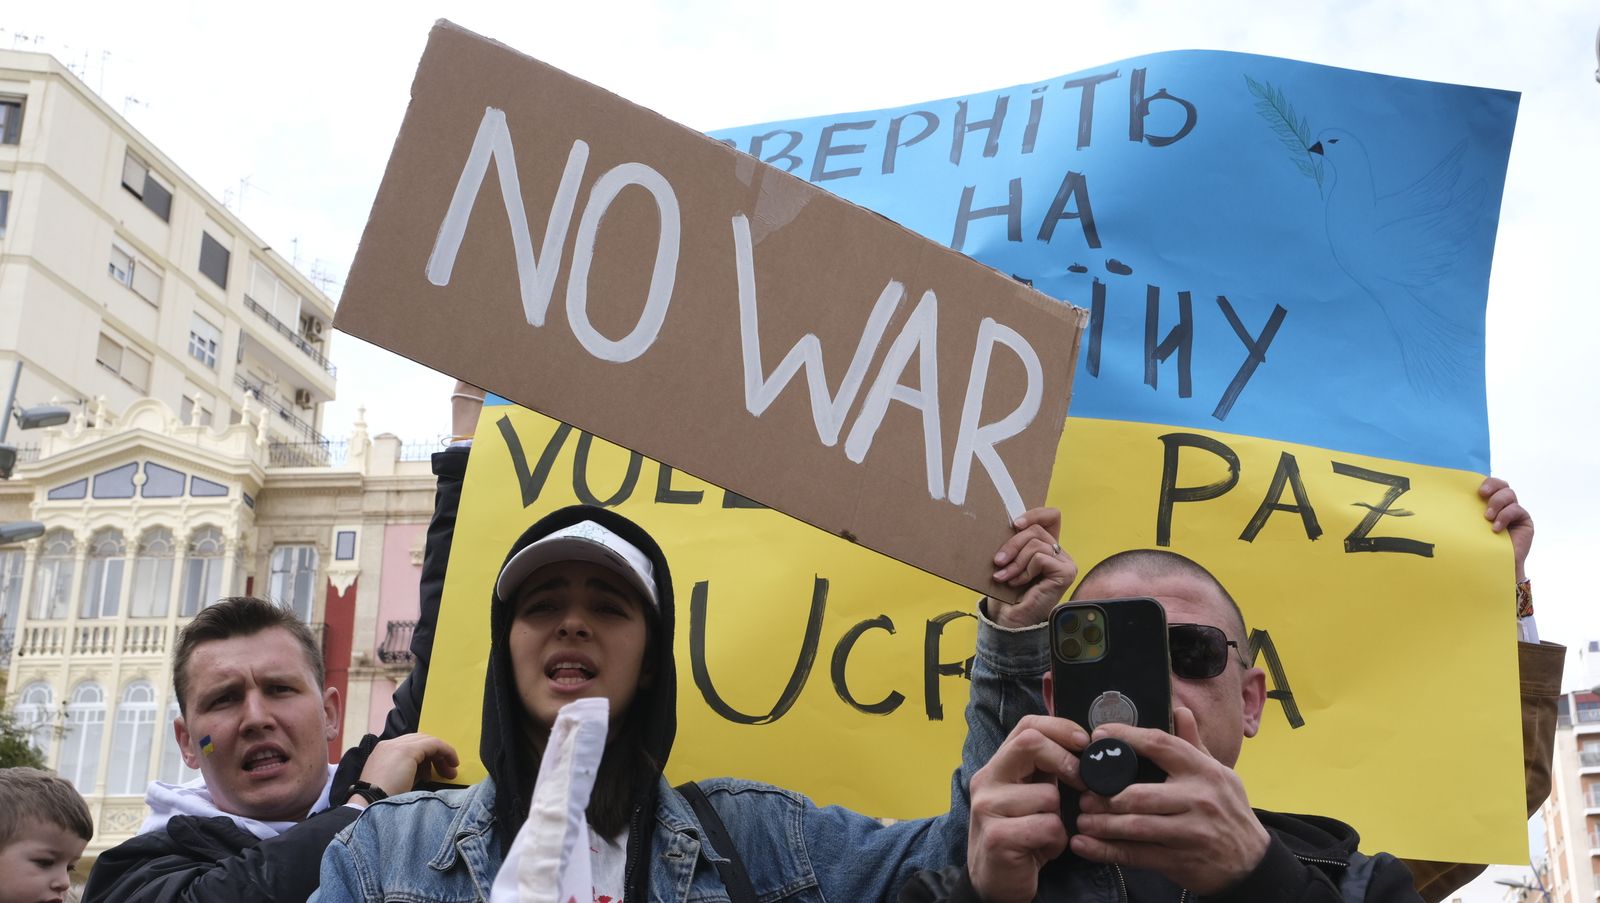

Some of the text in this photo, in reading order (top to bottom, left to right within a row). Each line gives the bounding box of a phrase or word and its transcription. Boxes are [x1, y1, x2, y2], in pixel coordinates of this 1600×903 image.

[951, 170, 1103, 251] НА
[425, 106, 1044, 526] NO WAR
[1157, 433, 1435, 558] PAZ
